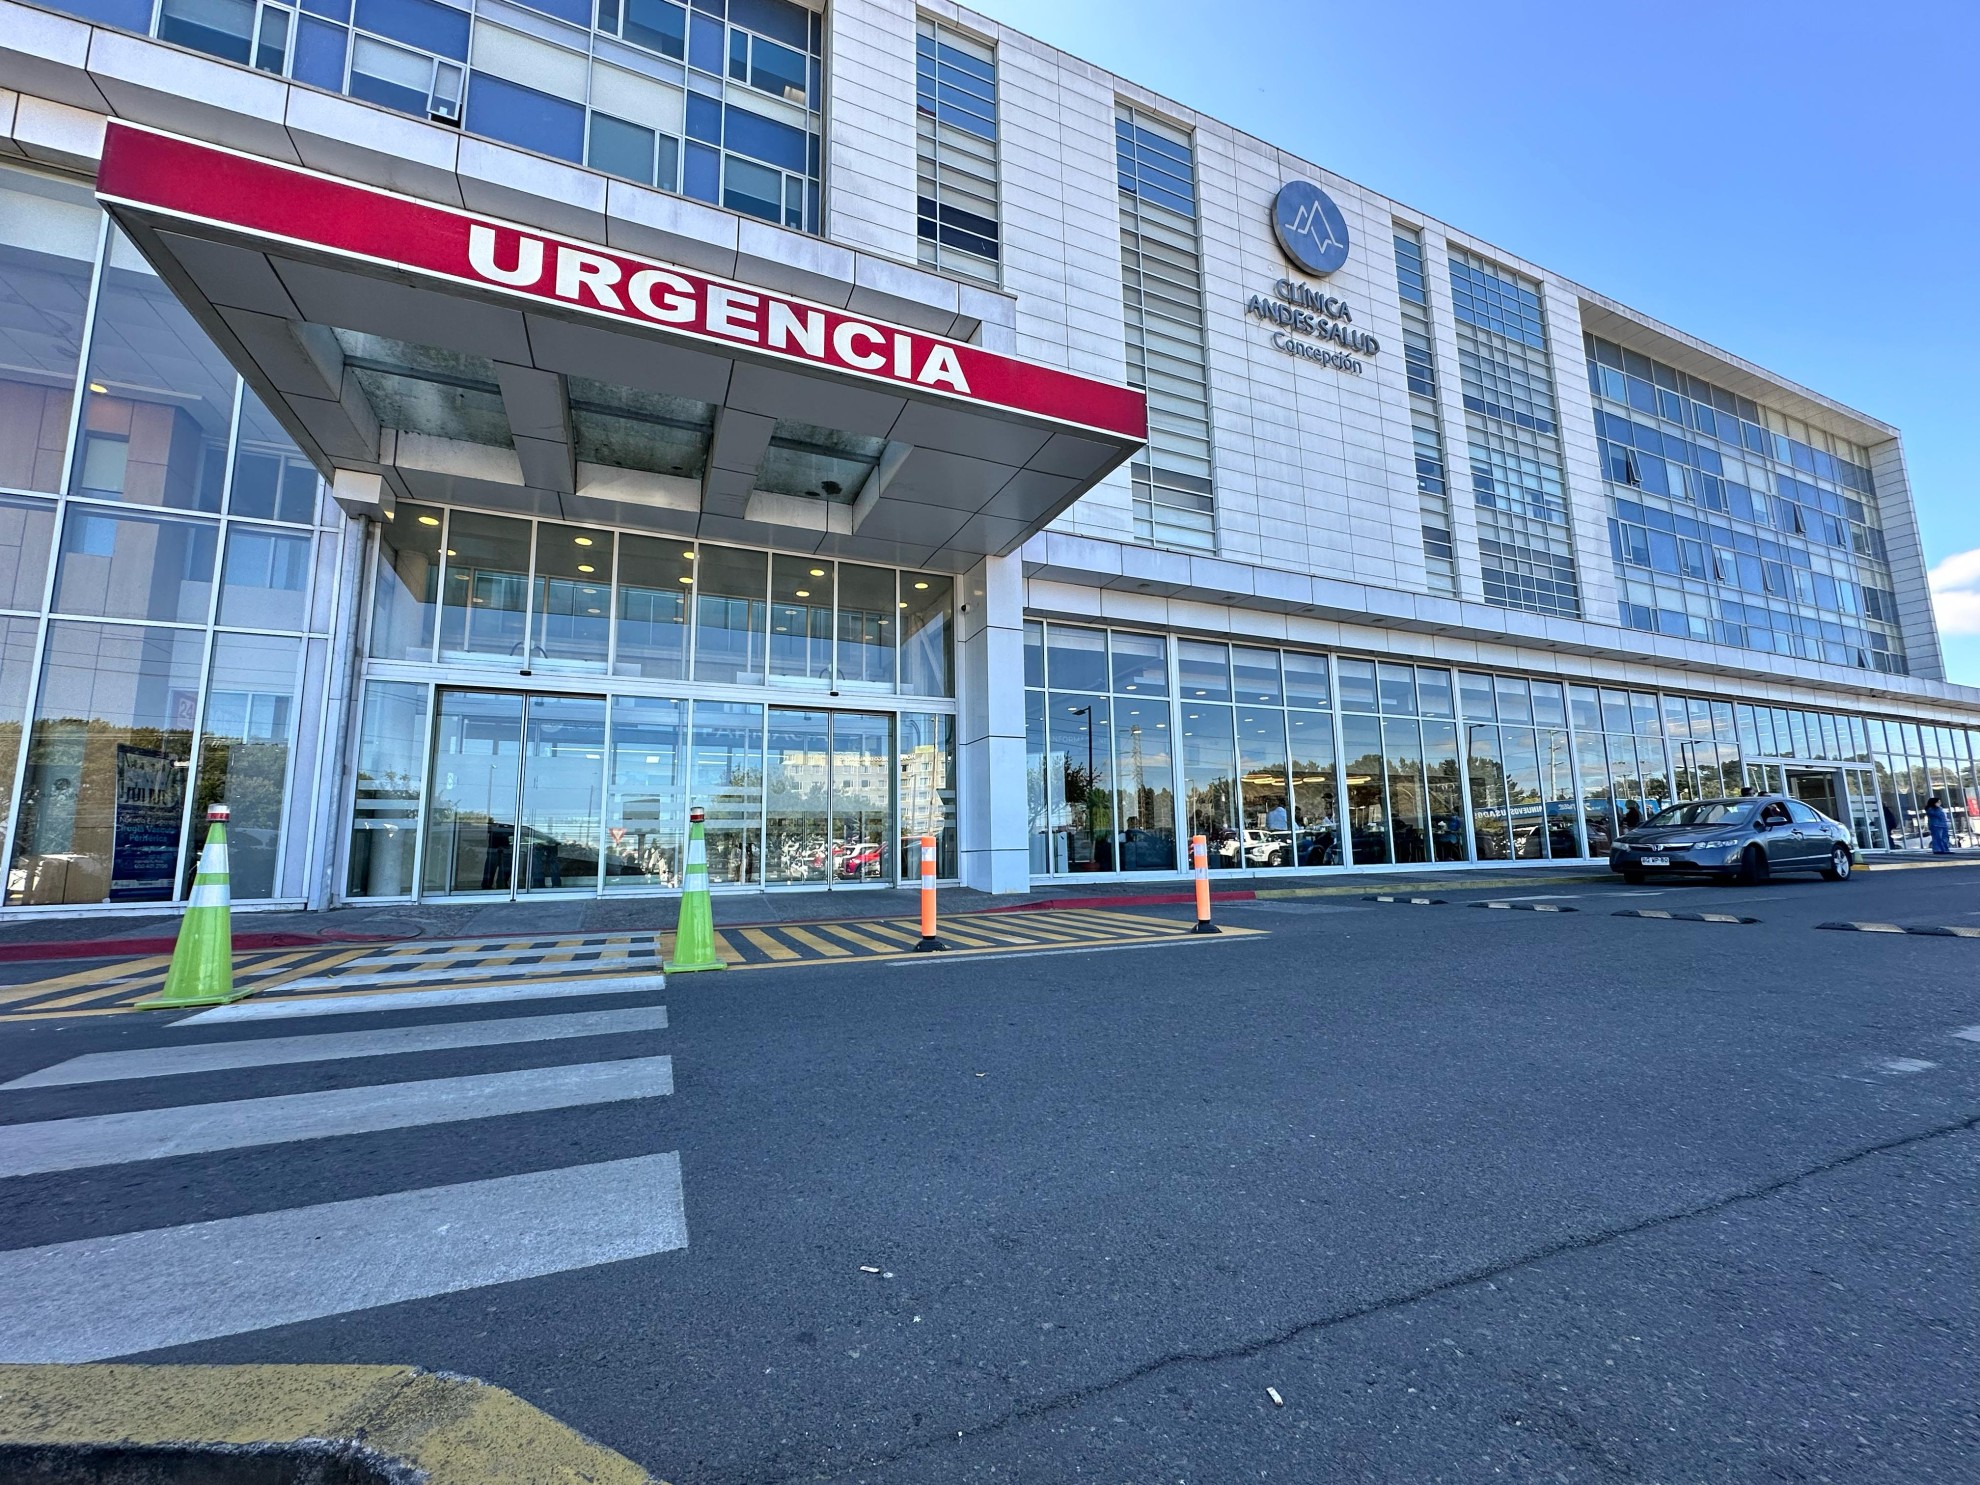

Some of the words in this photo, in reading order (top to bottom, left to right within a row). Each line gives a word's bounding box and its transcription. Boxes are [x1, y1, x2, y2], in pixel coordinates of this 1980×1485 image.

[468, 225, 971, 394] URGENCIA
[1248, 294, 1314, 335] ANDES
[1316, 318, 1380, 355] SALUD
[1274, 278, 1352, 323] CLÍNICA
[1271, 331, 1362, 375] Concepción
